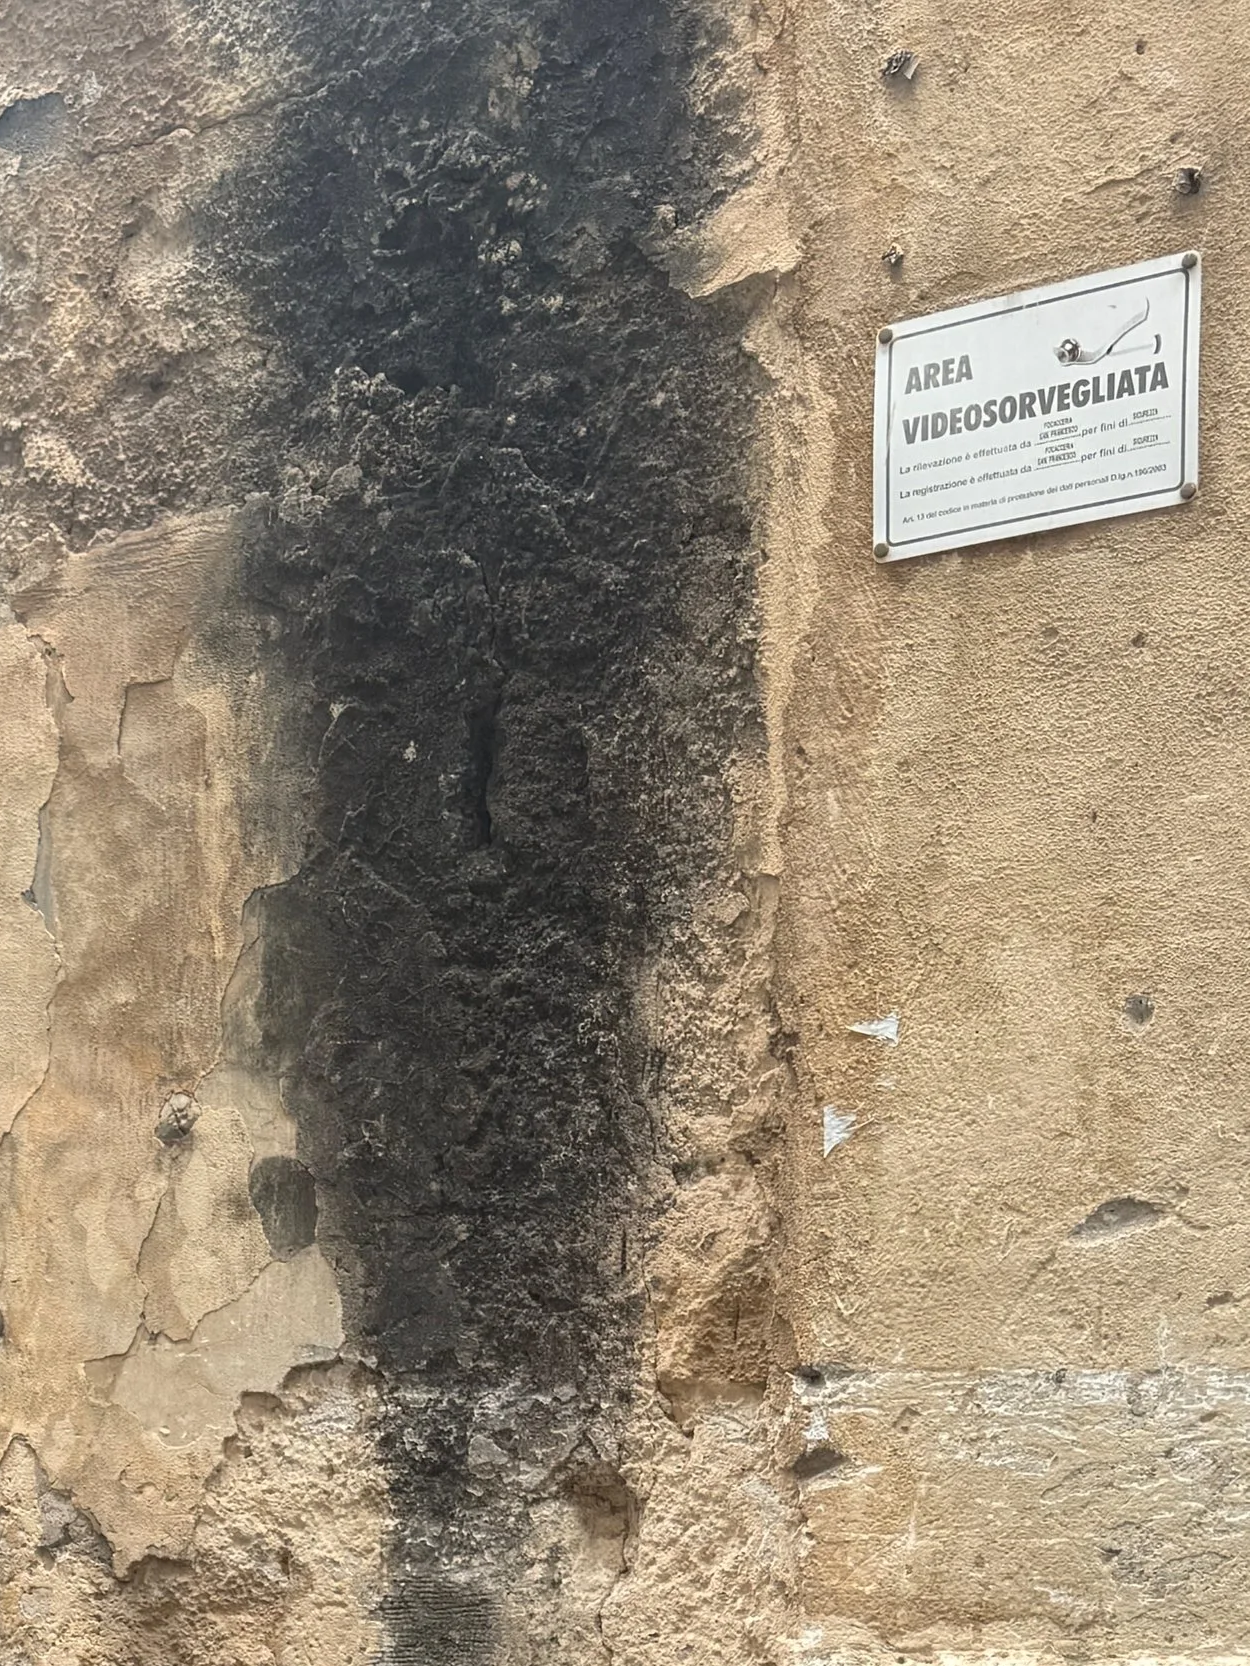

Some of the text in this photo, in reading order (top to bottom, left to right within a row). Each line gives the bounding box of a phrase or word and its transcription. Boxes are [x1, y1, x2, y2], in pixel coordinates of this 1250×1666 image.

[904, 353, 974, 395] AREA
[901, 361, 1170, 446] VIDEOSORVEGLIATA
[899, 465, 911, 475] La
[912, 454, 963, 471] rilevazione
[973, 443, 1018, 459] effettuata
[1019, 440, 1032, 450] da
[1081, 426, 1098, 438] per
[1100, 421, 1116, 432] fini
[1118, 418, 1128, 428] di
[899, 490, 911, 499] La
[912, 478, 968, 497] registrazione
[977, 469, 1019, 484] effettuata
[1020, 465, 1032, 475] da
[1080, 451, 1097, 463] per
[1099, 446, 1116, 458] fini
[1117, 443, 1128, 454] di
